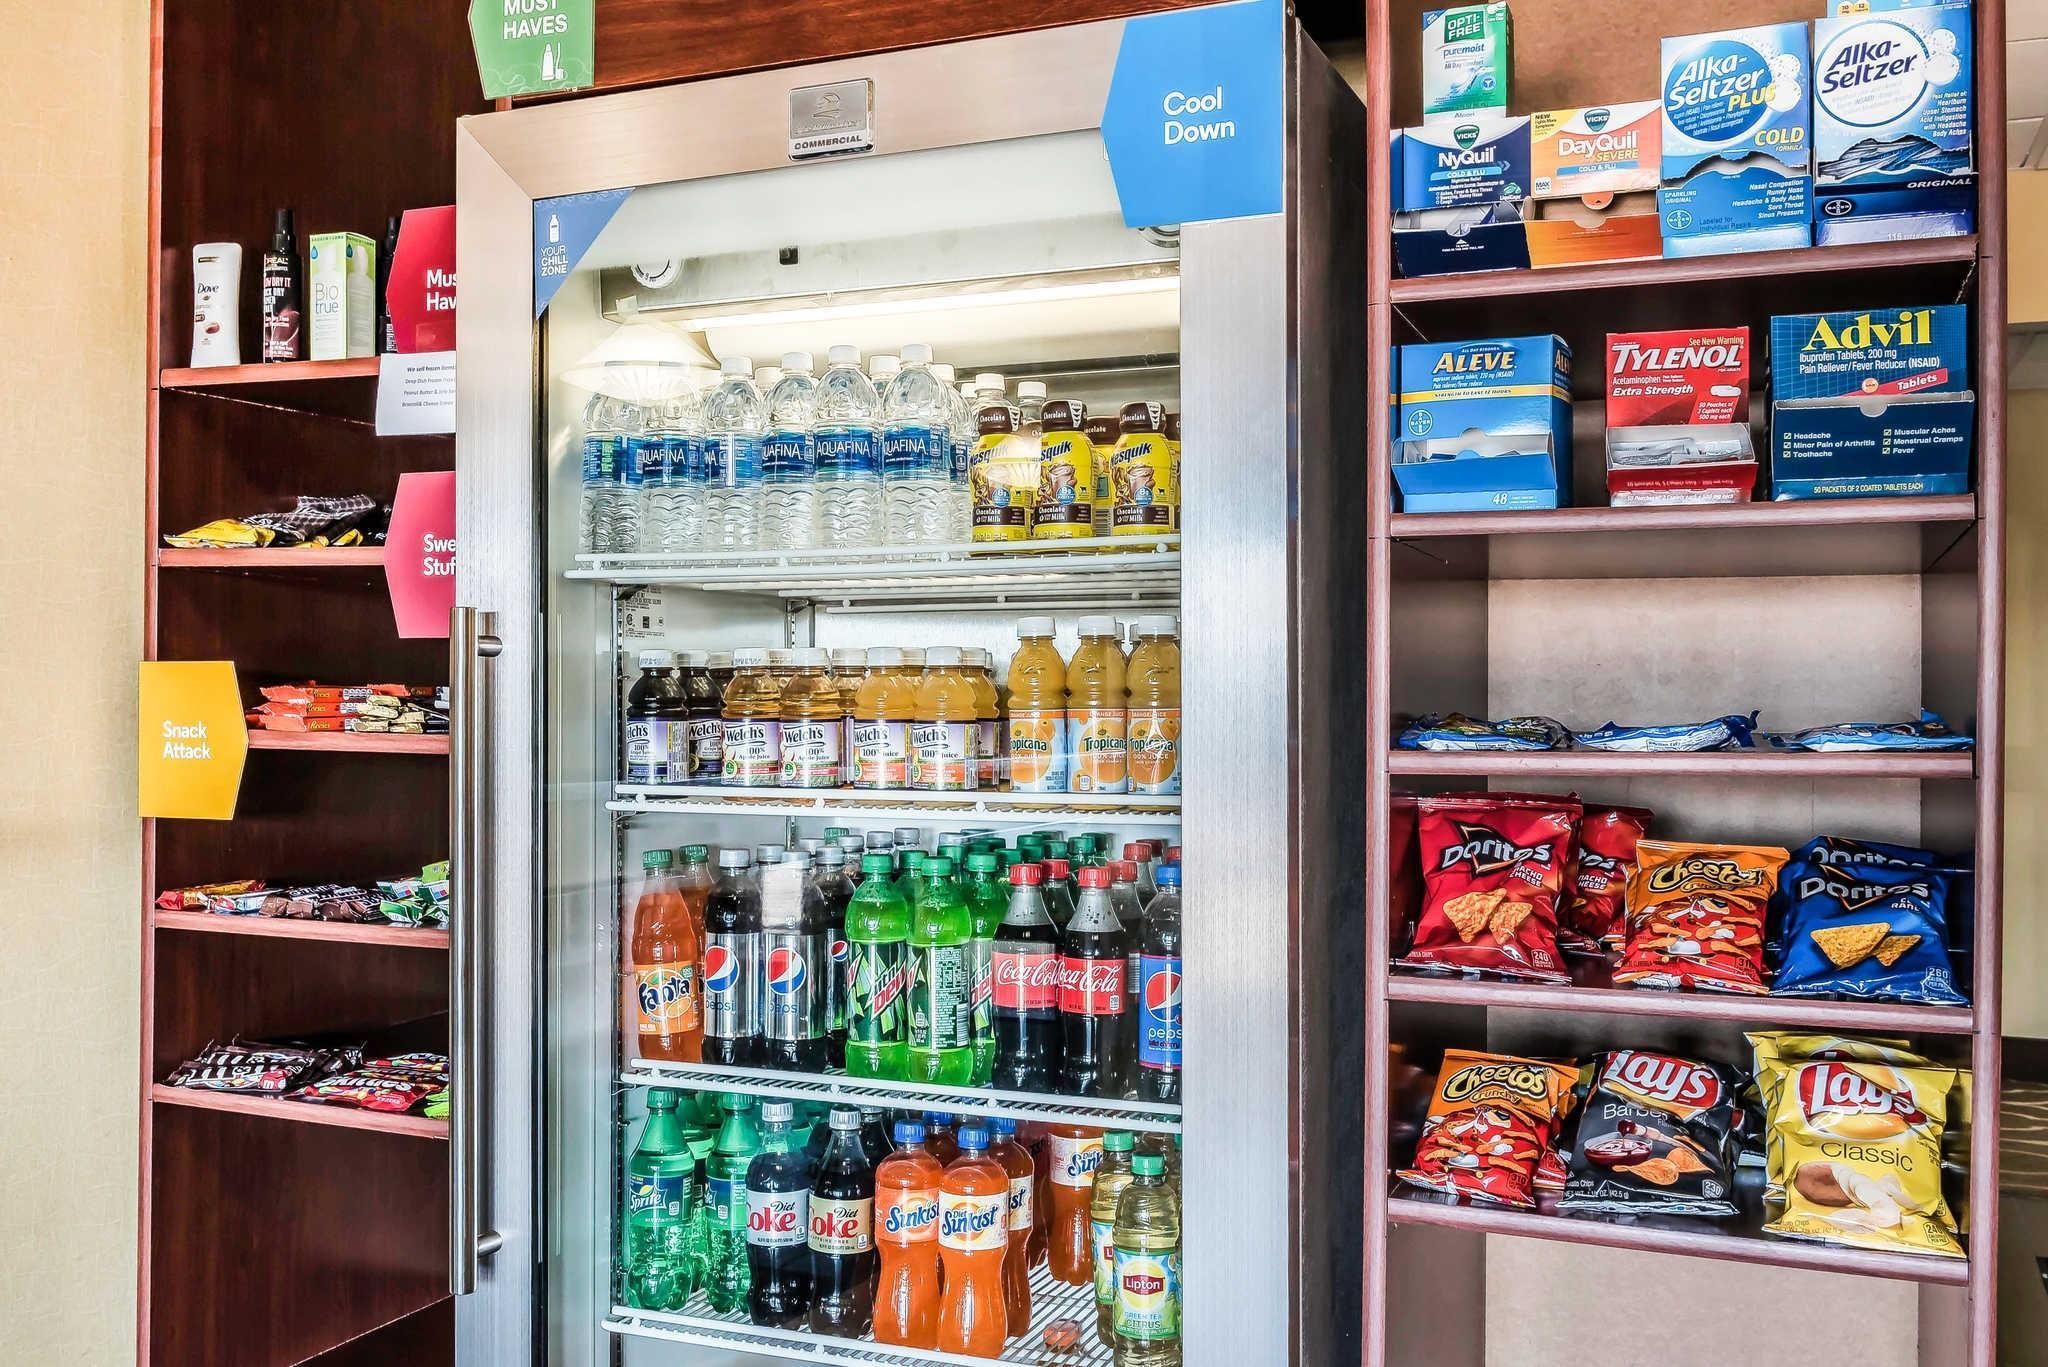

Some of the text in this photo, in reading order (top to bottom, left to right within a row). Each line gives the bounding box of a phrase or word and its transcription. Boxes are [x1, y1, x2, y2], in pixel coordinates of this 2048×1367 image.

[504, 0, 559, 15] MUST
[503, 15, 569, 39] HAVES
[1447, 14, 1481, 30] OPTI-
[1448, 23, 1481, 41] FREE
[1827, 40, 1901, 72] Alka-
[1672, 54, 1748, 89] Alka-
[1821, 54, 1917, 94] Seltzer
[1667, 69, 1765, 112] Seltzer
[1164, 85, 1223, 116] Cool
[1164, 120, 1235, 145] Down
[1456, 131, 1478, 140] VICKS
[1754, 127, 1805, 146] COLD
[794, 135, 863, 150] COMMERCIAL
[1558, 132, 1637, 160] DayQuil
[1438, 147, 1495, 170] NyQuil
[1595, 149, 1639, 162] SEVERE
[1749, 179, 1804, 191] Nasal Congestion
[1906, 178, 1972, 189] ORIGINAL
[1766, 189, 1787, 197] Runny
[1732, 199, 1763, 207] Headache
[1770, 196, 1788, 204] Body
[1767, 201, 1804, 211] Sore Throat
[1758, 209, 1804, 219] Sinus Pressure
[540, 245, 566, 257] YOUR
[541, 255, 569, 267] CHILL
[541, 265, 567, 277] ZONE
[197, 282, 220, 295] Dove
[315, 282, 339, 301] Bio
[315, 300, 339, 314] true
[1801, 309, 1933, 351] Advil
[1689, 336, 1744, 346] See New Warning
[1433, 352, 1515, 374] ALEVE
[1611, 343, 1741, 374] TYLENOL
[1799, 349, 1897, 363] Ibuprofen Tablets, 200 mg
[1799, 356, 1940, 374] Pain Reducer (NSAID)
[1612, 375, 1661, 386] Acetaminophen
[1897, 373, 1938, 391] Tablets
[1612, 384, 1694, 397] Extra Strength
[979, 414, 1006, 423] Chocolate
[1043, 410, 1067, 420] Chocolate
[1122, 413, 1146, 422] Chocolate
[1793, 432, 1832, 440] Headache
[1894, 426, 1956, 436] Muscular Aches
[1793, 439, 1876, 450] Minor Pain of Arthritis
[1893, 436, 1964, 445] Menstrual Cramps
[816, 439, 871, 458] AQUAFINA
[1793, 450, 1833, 458] Toothache
[1813, 486, 1822, 494] 50
[1821, 485, 1848, 493] PACKETS
[1860, 484, 1883, 492] COATED
[1883, 483, 1907, 491] TABLETS
[1492, 493, 1508, 505] 48
[975, 506, 1000, 516] Chocolate
[1038, 505, 1066, 515] Chocolate
[1116, 506, 1143, 516] Chocolate
[987, 514, 1000, 523] Milk
[1051, 513, 1065, 522] Milk
[1129, 513, 1143, 523] Milk
[162, 720, 208, 738] Snack
[726, 726, 765, 743] Welch's
[784, 725, 824, 743] Welch's
[854, 727, 888, 743] Welch's
[912, 727, 947, 744] Welch's
[1084, 736, 1127, 751] Tropicana
[162, 742, 211, 760] Attack
[1441, 838, 1552, 870] Doritos
[1648, 861, 1764, 893] Cheetos
[1801, 877, 1929, 900] Doritos
[1534, 950, 1549, 961] 240
[1928, 967, 1949, 980] 260
[1442, 1063, 1548, 1101] Cheetos
[1470, 1090, 1521, 1104] Crunchy
[1083, 1152, 1097, 1160] Diet
[1820, 1142, 1914, 1172] Classic
[1510, 1173, 1527, 1185] 310
[1704, 1181, 1721, 1195] 230
[631, 1191, 664, 1211] Sprite
[770, 1201, 795, 1212] Diet
[834, 1207, 859, 1219] Diet
[886, 1200, 939, 1233] Sunkist
[952, 1210, 967, 1219] Diet
[942, 1205, 999, 1237] Sunkist
[1126, 1278, 1161, 1294] Lipton
[1126, 1319, 1161, 1330] CITRUS
